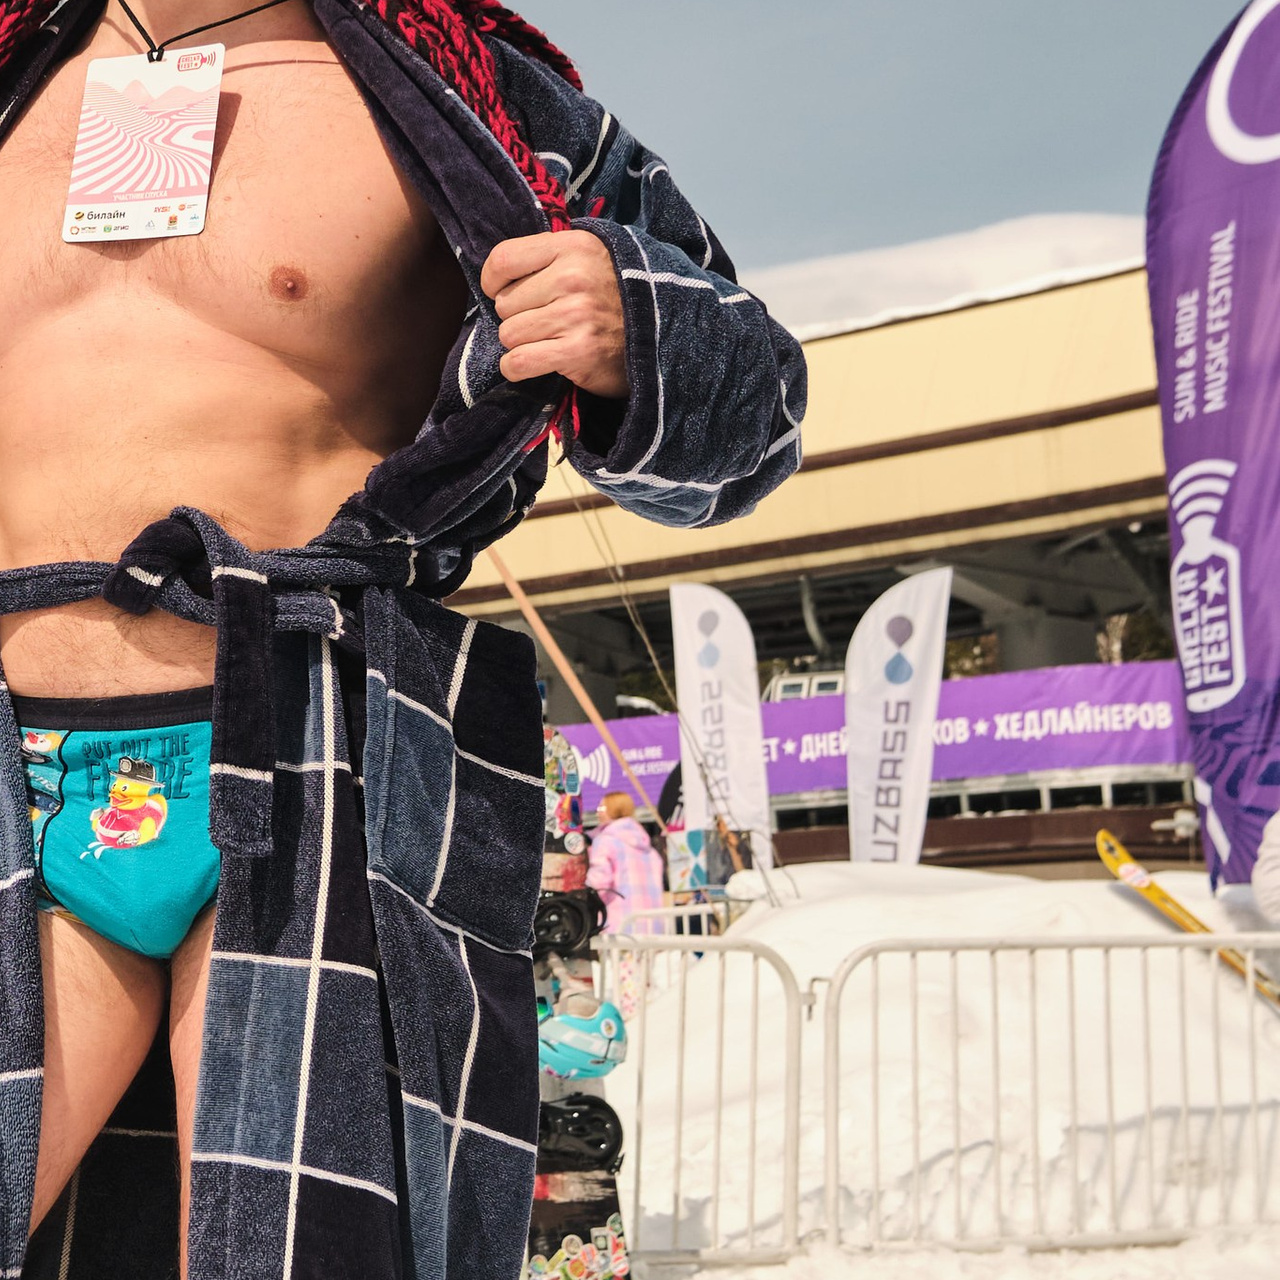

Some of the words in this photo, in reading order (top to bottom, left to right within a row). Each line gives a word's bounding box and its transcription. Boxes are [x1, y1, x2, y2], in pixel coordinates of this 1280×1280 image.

[87, 210, 126, 220] билайн
[1206, 220, 1236, 334] FESTIVAL
[1174, 289, 1199, 349] RIDE
[1175, 347, 1197, 369] &
[1202, 331, 1230, 414] MUSIC
[1173, 369, 1197, 424] SUN
[1200, 603, 1232, 685] FEST
[81, 740, 112, 759] PUT
[119, 738, 151, 759] OUT
[159, 733, 191, 758] THE
[993, 701, 1173, 741] ХЕДЛАЙНЕРОВ
[86, 757, 194, 802] FIRE
